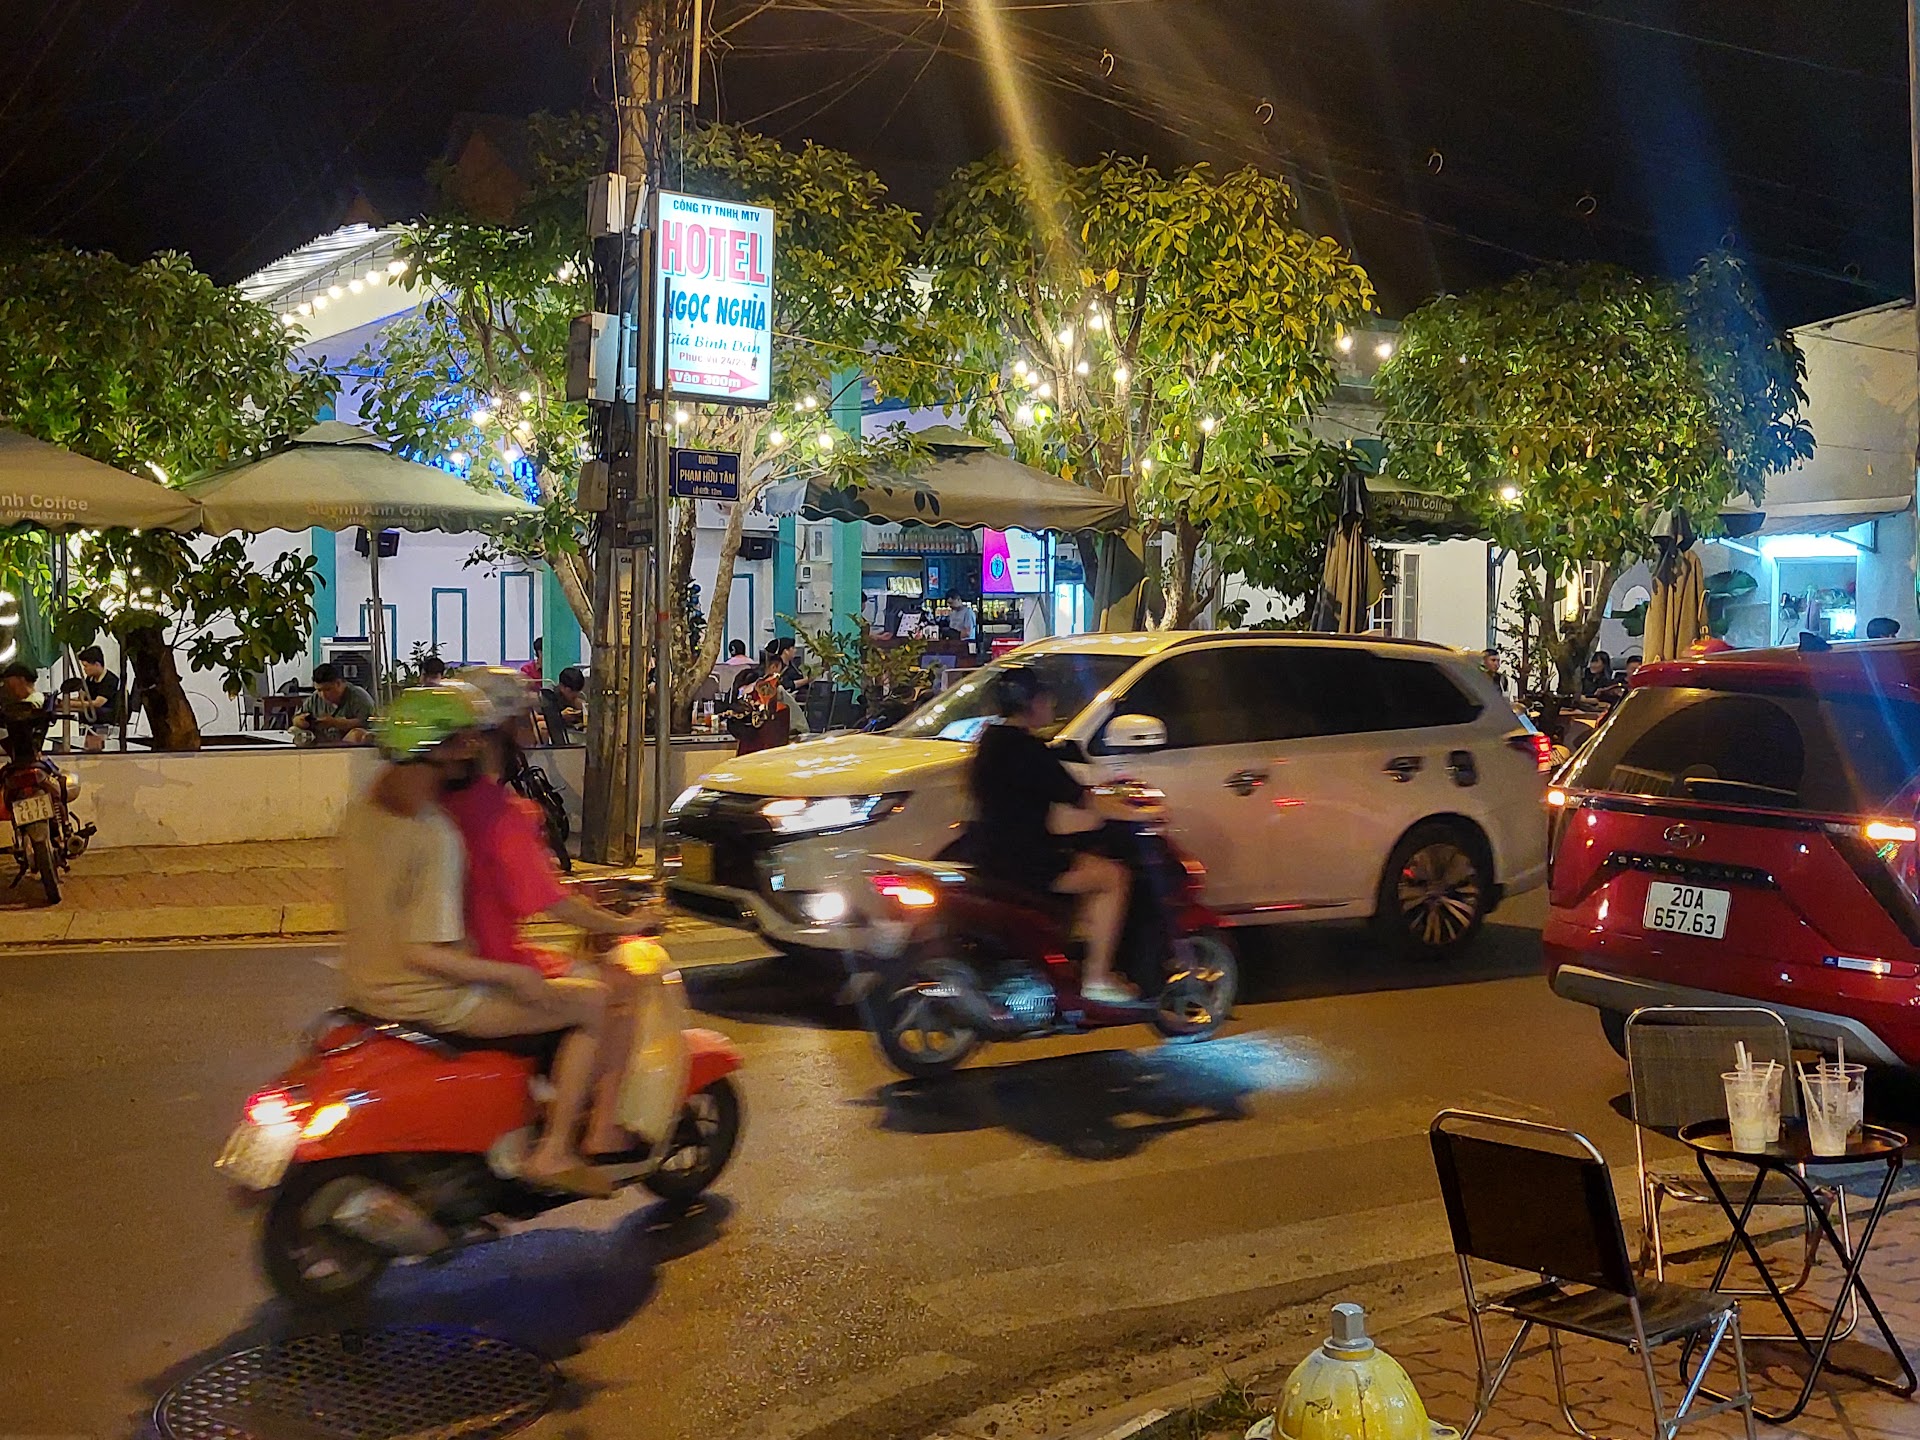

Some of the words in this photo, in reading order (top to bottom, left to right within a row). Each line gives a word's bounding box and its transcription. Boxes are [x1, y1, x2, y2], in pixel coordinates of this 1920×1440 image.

[673, 198, 699, 213] CÔNG
[701, 204, 712, 215] TY
[714, 206, 739, 219] TNHH
[741, 210, 760, 222] MTV
[661, 219, 769, 287] HOTEL
[674, 370, 700, 384] Vào
[703, 374, 742, 388] 300m
[679, 469, 702, 484] PHẠM
[719, 470, 735, 485] TÂM
[30, 494, 88, 511] Coffee
[1399, 495, 1419, 508] Anh
[1421, 497, 1453, 512] Coffee
[1671, 886, 1704, 910] 20A
[1653, 907, 1717, 935] 657.63
